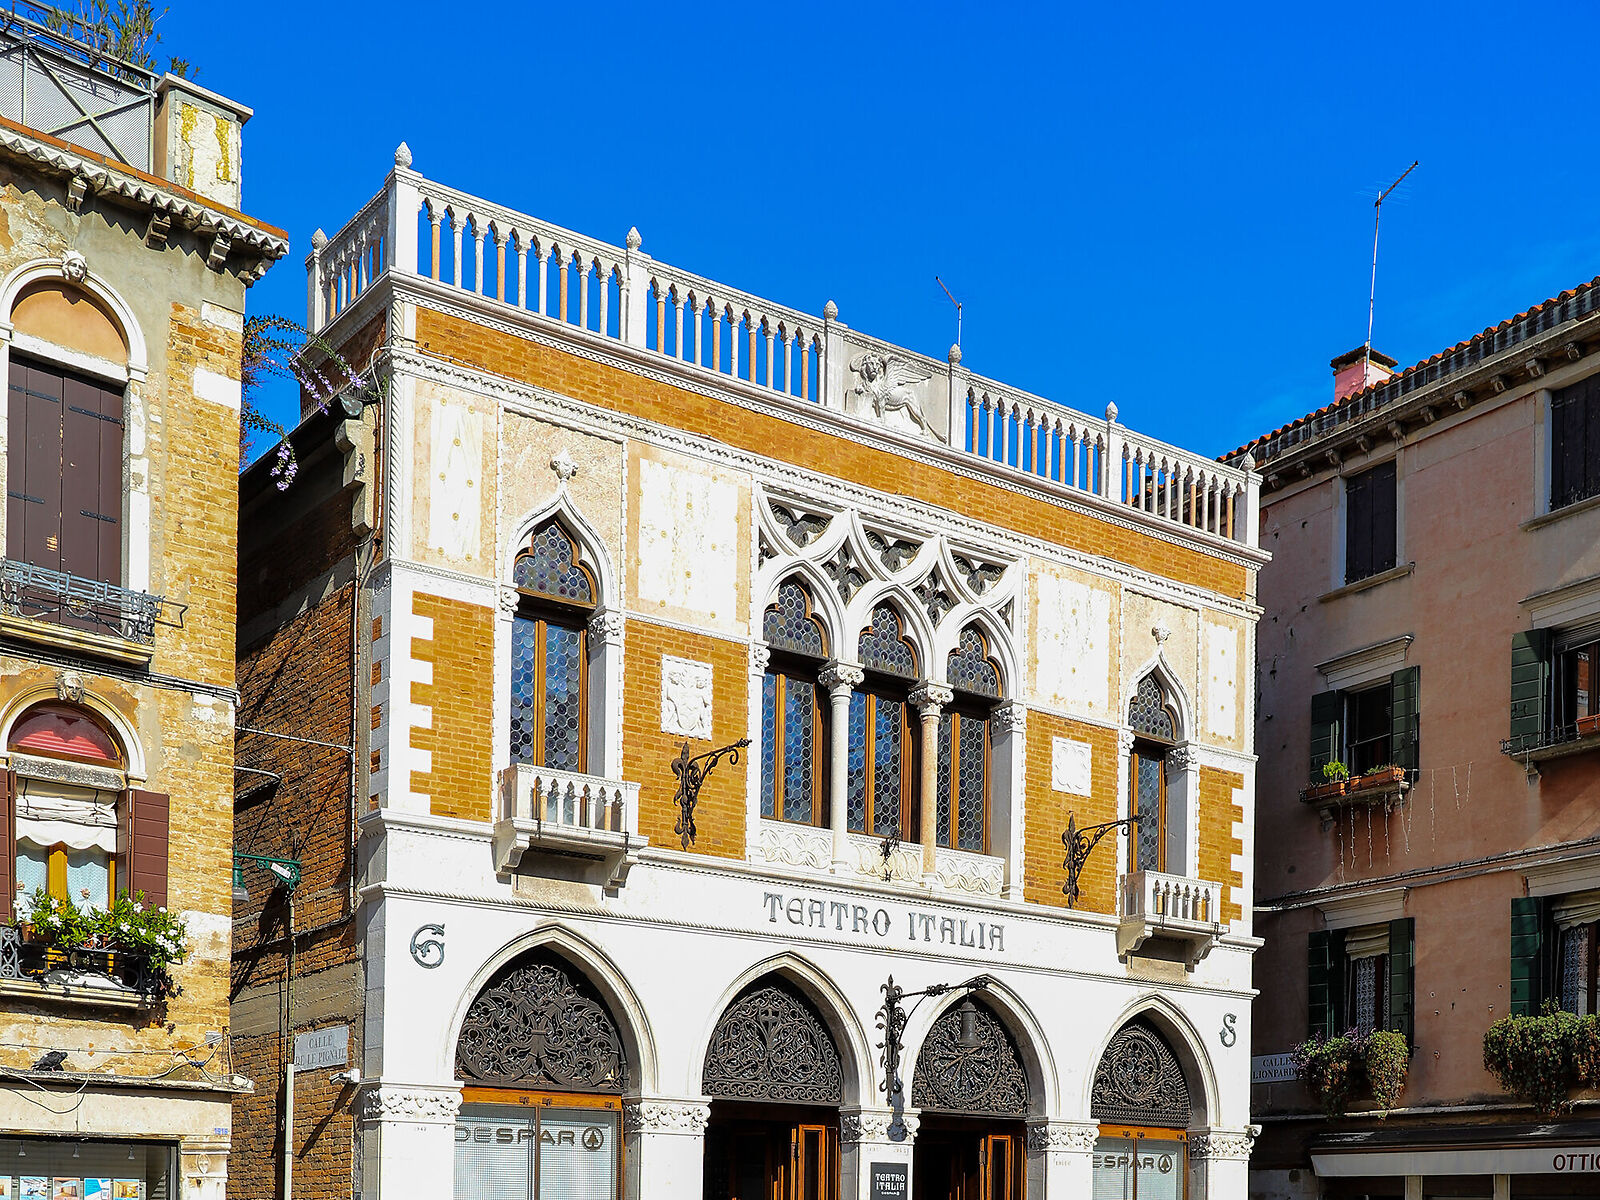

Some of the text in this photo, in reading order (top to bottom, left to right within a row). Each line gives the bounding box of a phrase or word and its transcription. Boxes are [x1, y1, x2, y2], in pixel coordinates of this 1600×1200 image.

[763, 891, 1006, 952] TEATRO ITALIA
[308, 1034, 333, 1049] CALLE
[307, 1053, 317, 1065] LE
[1262, 1056, 1291, 1067] CALLE
[455, 1126, 576, 1146] DESPAR
[875, 1173, 906, 1182] TEATRO
[876, 1182, 905, 1191] ITALIA
